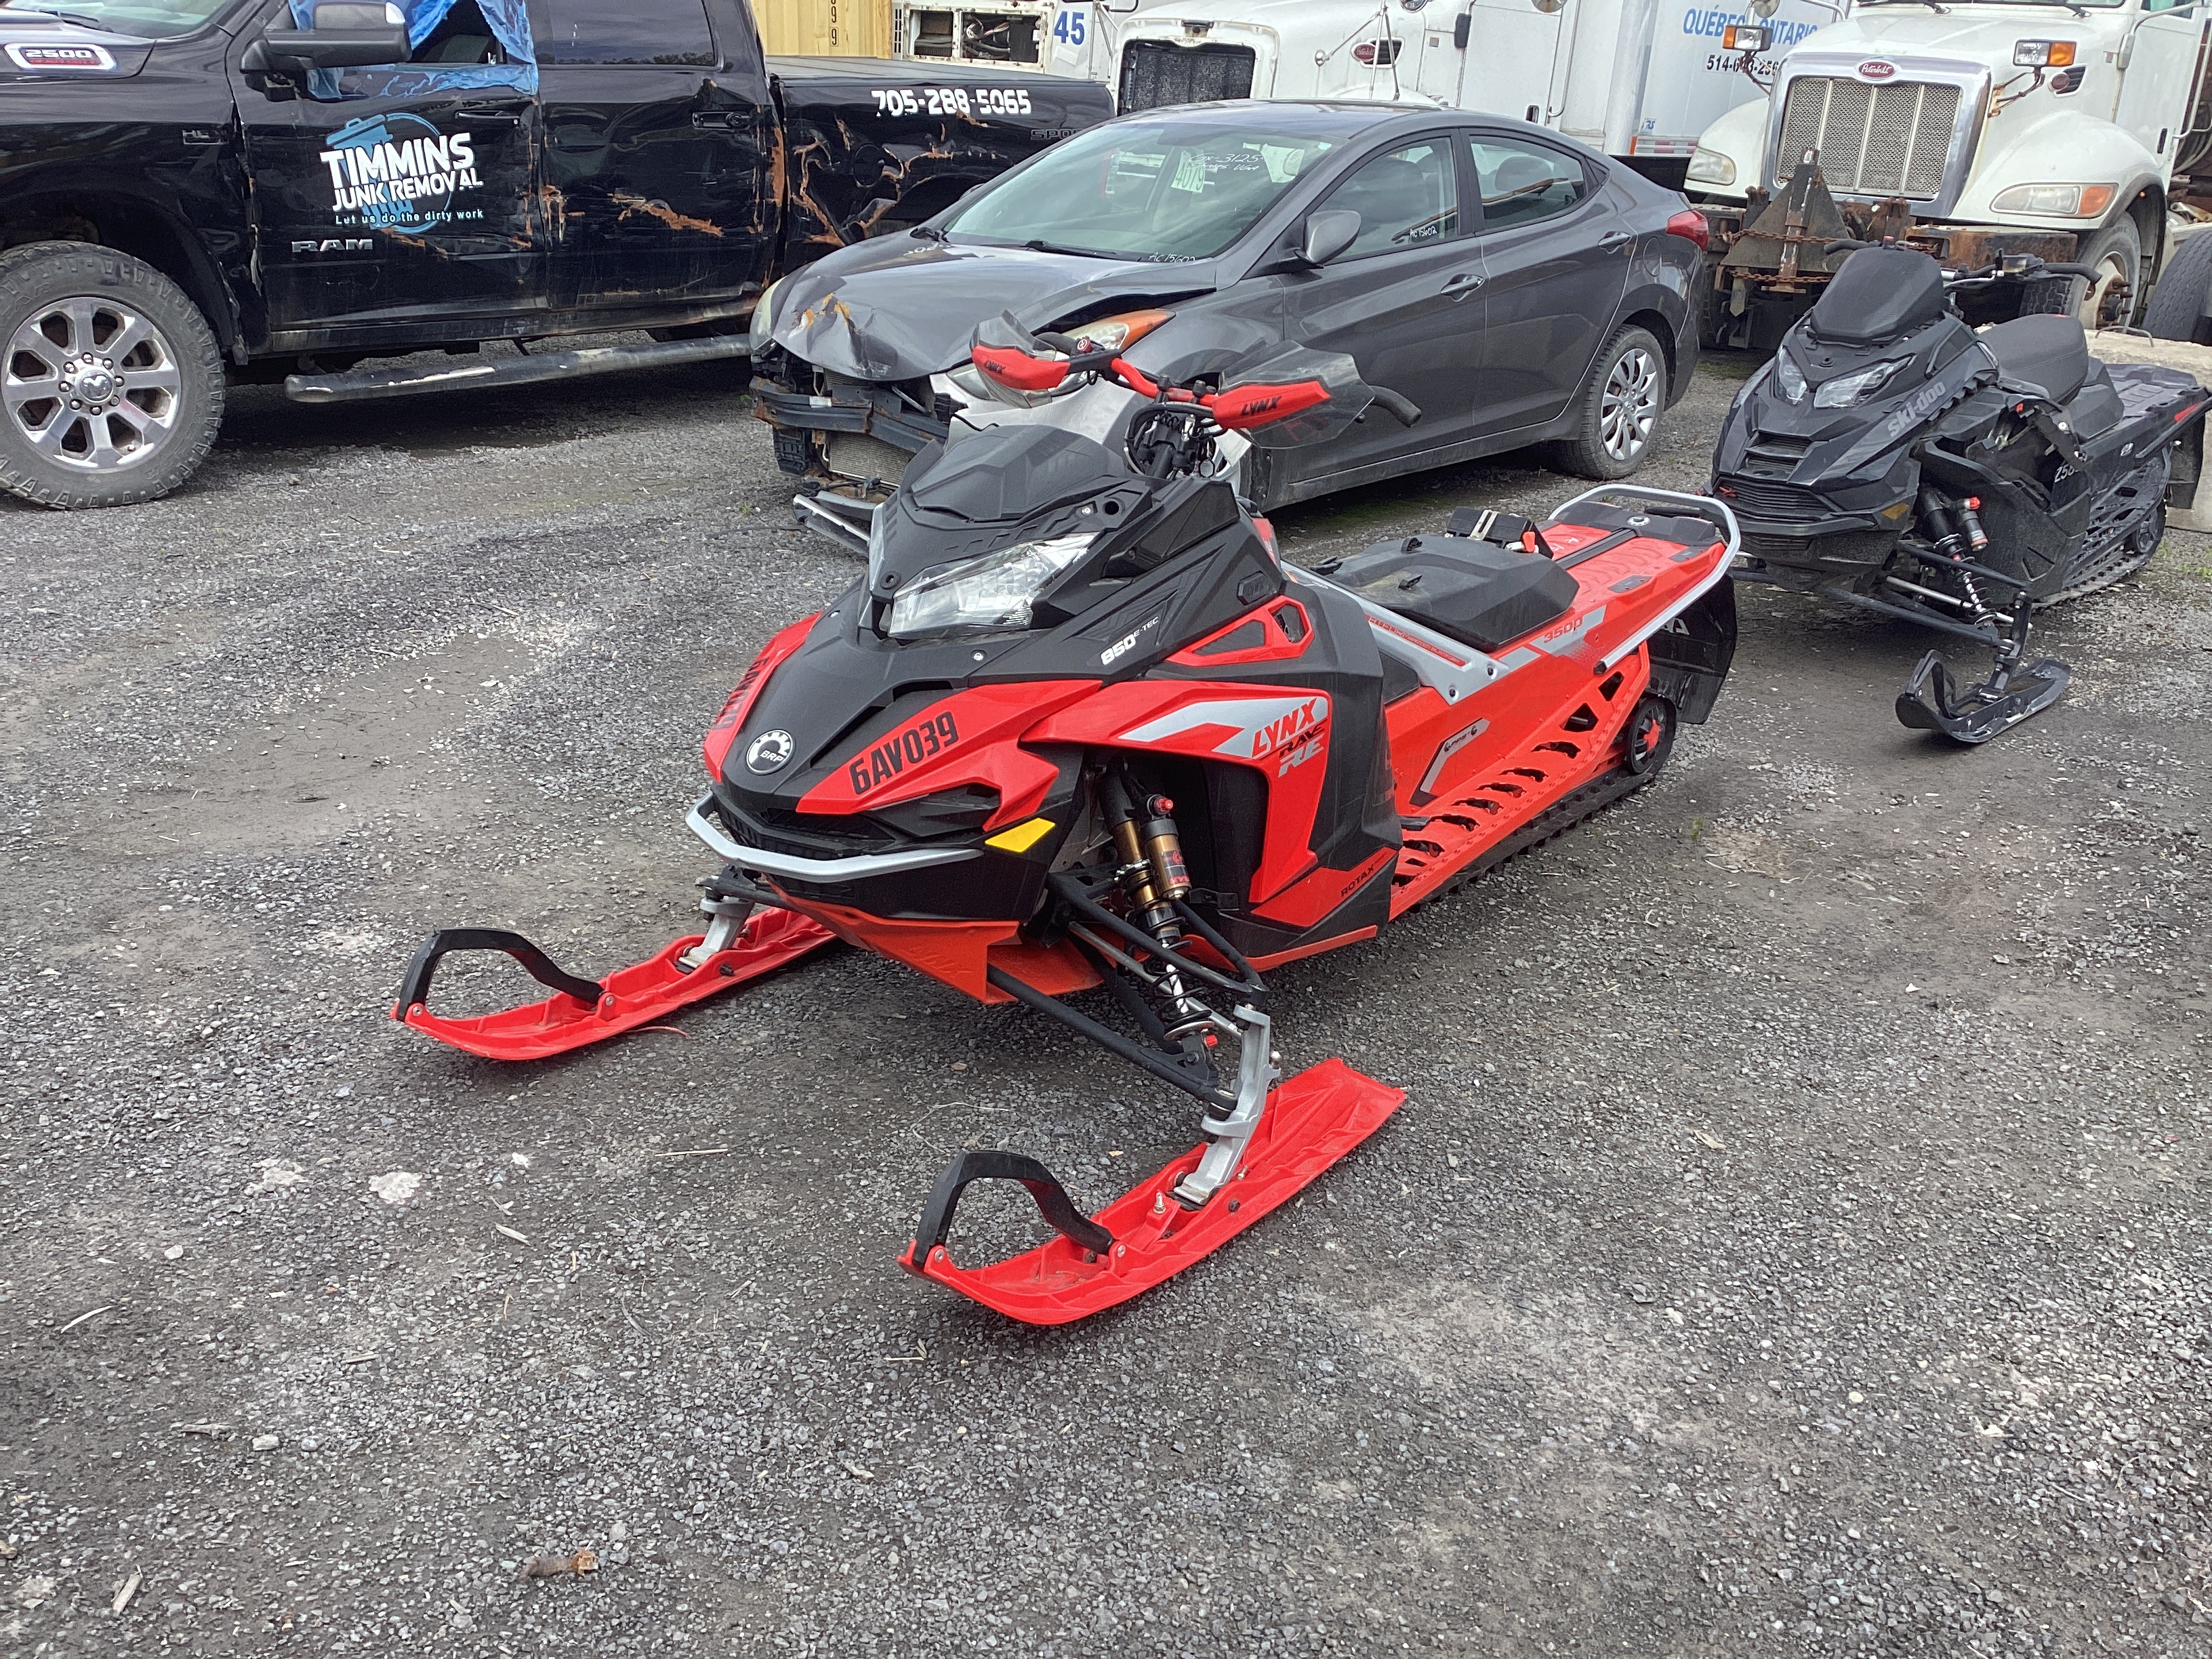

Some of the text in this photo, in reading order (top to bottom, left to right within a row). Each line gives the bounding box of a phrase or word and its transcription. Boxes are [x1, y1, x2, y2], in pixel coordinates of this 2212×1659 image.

[1053, 10, 1085, 45] 45
[25, 49, 92, 58] 2500
[1861, 63, 1892, 74] Peterbilt
[871, 88, 1032, 117] 705-288-5065
[319, 132, 474, 189] TIMMINS
[332, 167, 484, 211] JUNK REMOVAL
[335, 209, 483, 224] Let us do the dirty work
[291, 239, 373, 253] RAM
[1241, 396, 1283, 416] LYNX
[1887, 382, 1946, 437] ski-doo
[1100, 615, 1159, 665] 850 E-TEC
[1252, 697, 1317, 758] LYNX
[760, 750, 785, 762] BRP
[849, 711, 960, 795] 6AV039
[1277, 732, 1326, 779] RE
[1340, 863, 1374, 897] ROTAX
